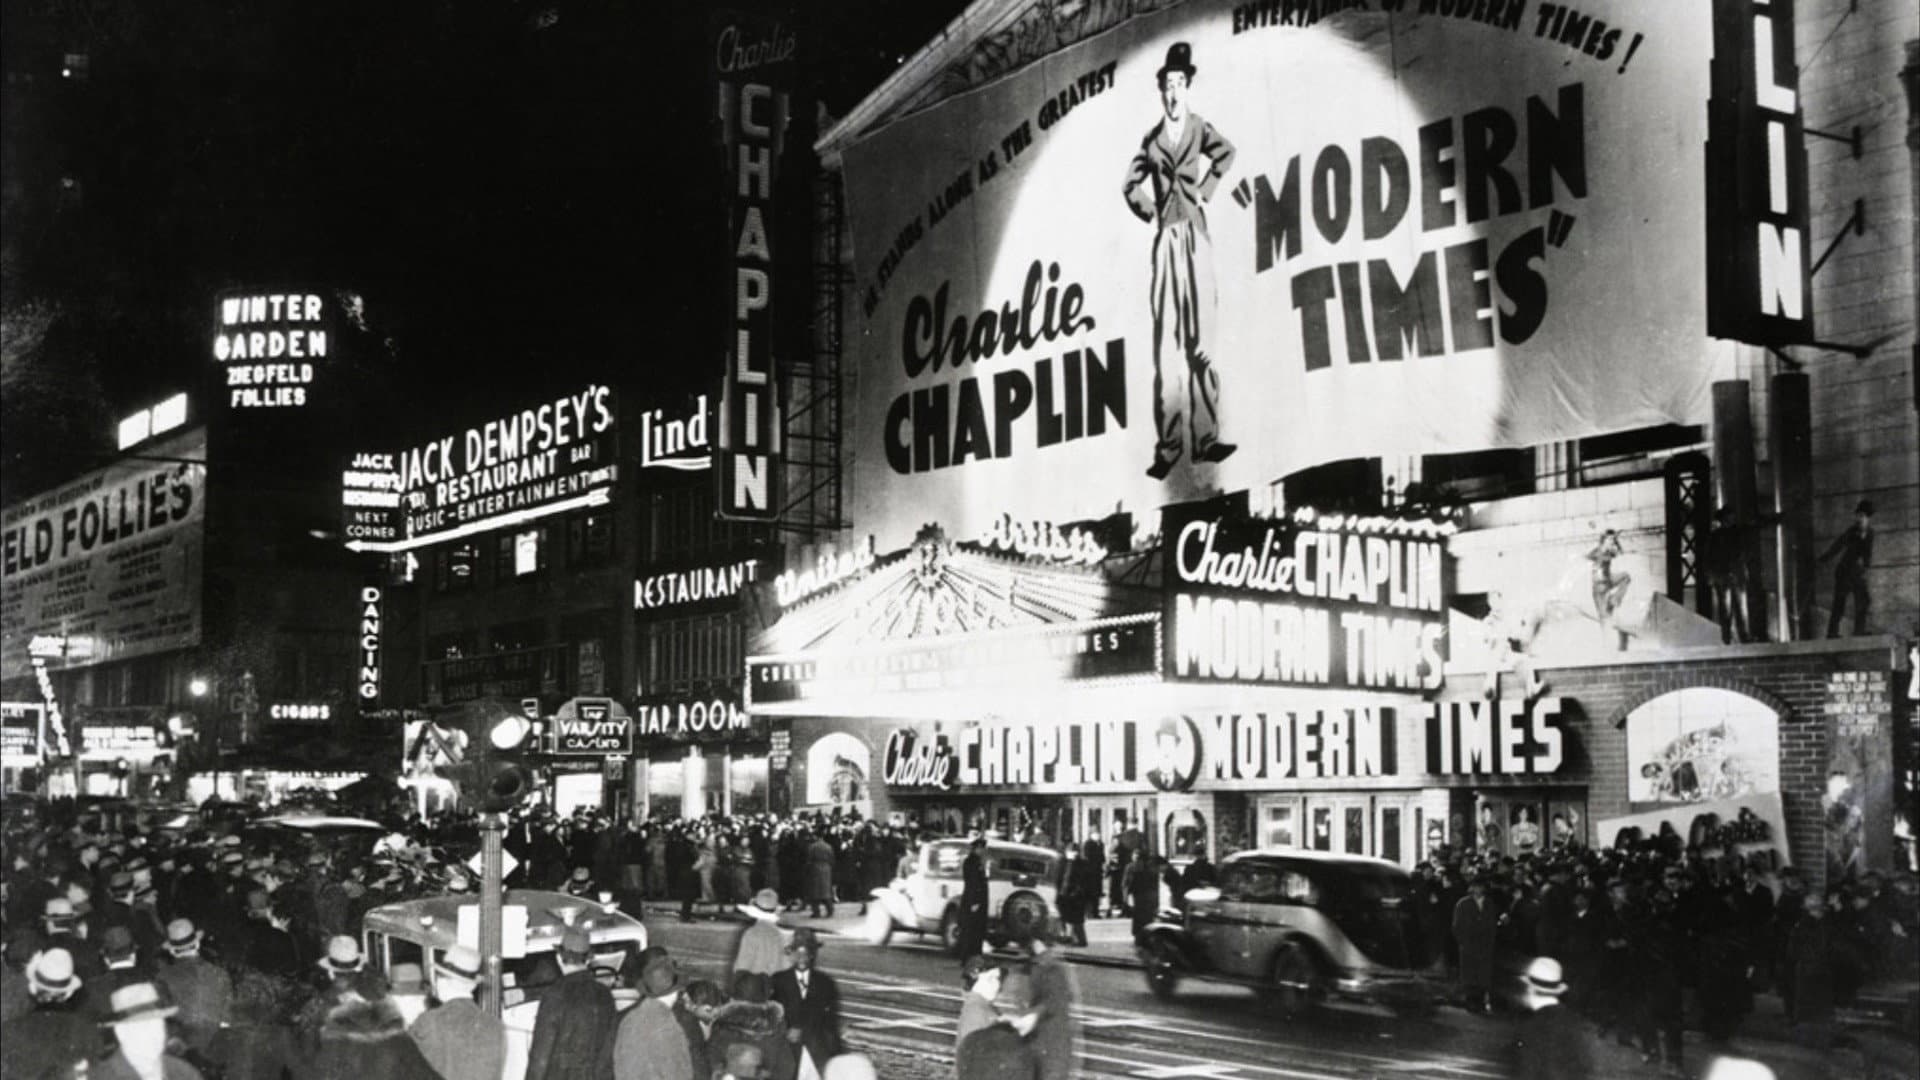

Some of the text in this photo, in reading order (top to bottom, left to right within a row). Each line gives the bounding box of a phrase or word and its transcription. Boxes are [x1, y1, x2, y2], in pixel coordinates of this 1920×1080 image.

[717, 23, 797, 72] Charlie
[928, 169, 974, 229] ALONE
[978, 151, 998, 185] AS
[1001, 119, 1032, 163] THE
[1037, 60, 1118, 131] GREATEST
[1754, 0, 1803, 321] LIN
[222, 295, 322, 324] WINTER
[734, 83, 771, 509] CHAPLIN
[903, 260, 1096, 378] Charlie
[214, 331, 326, 360] GARDEN
[228, 364, 312, 385] ZIEGFELD
[232, 387, 305, 407] FOLLIES
[884, 338, 1127, 475] CHAPLIN
[351, 453, 394, 469] JACK
[398, 384, 611, 492] JACK DEMPSEY'S
[436, 449, 558, 507] RESTAURANT
[571, 444, 592, 464] BAR
[458, 471, 590, 521] ENTERTAINMENT
[61, 464, 193, 558] FOLLIES
[345, 524, 396, 538] CORNER
[354, 511, 388, 523] NEXT
[634, 560, 758, 610] RESTAURANT
[1176, 519, 1297, 592] Charlie
[1295, 530, 1443, 612] CHAPLIN
[359, 586, 381, 698] DANCING
[1175, 593, 1444, 689] MODERN TIMES
[270, 704, 331, 719] CIGARS
[559, 719, 628, 737] VARSITY
[638, 698, 749, 735] TAP ROOM
[883, 697, 1564, 791] Charlie CHAPLIN MODERN TIMES
